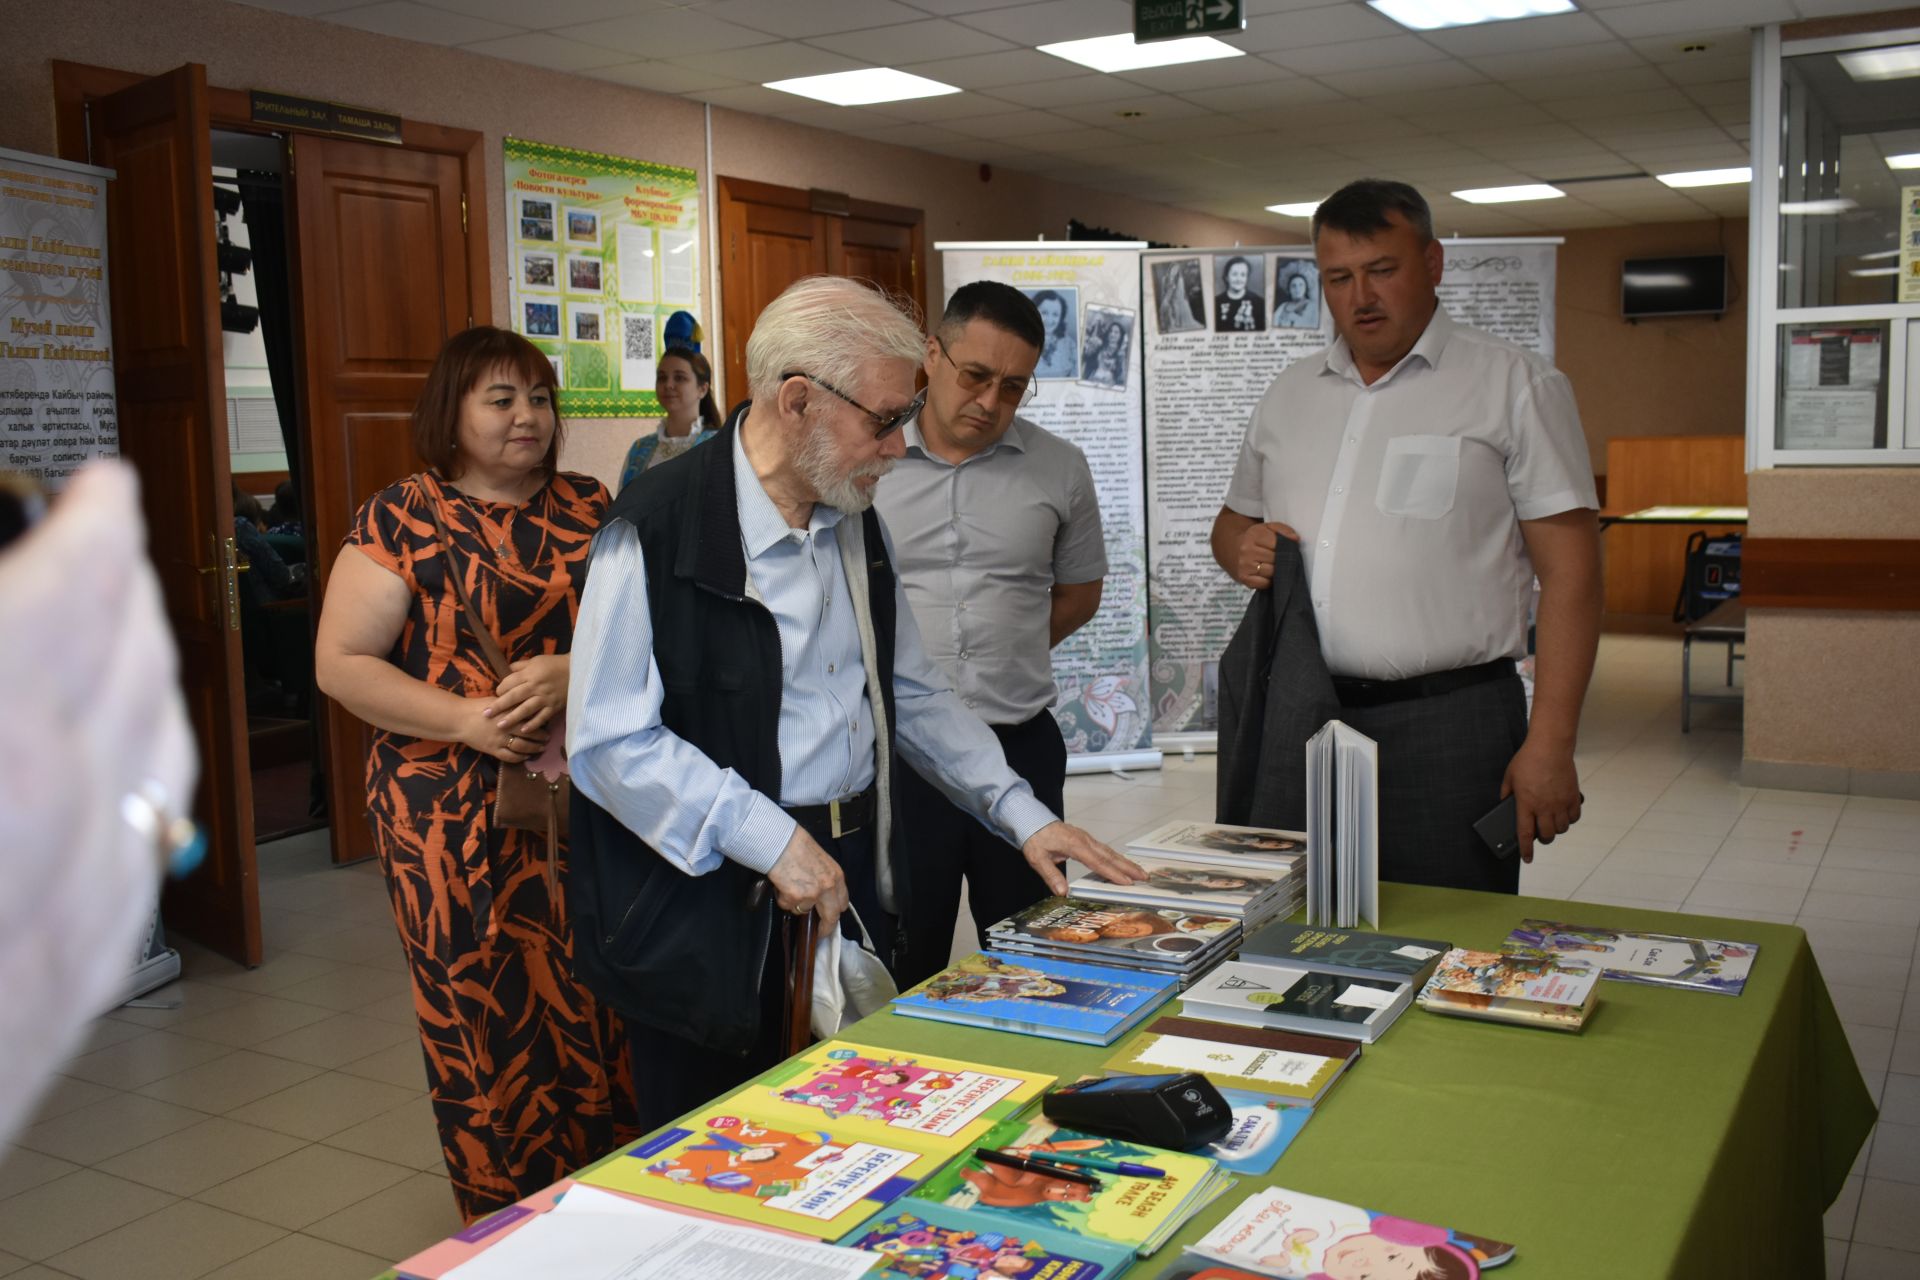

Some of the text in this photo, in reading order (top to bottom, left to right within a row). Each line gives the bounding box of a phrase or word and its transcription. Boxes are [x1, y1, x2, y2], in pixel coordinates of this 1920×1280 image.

[0, 389, 114, 402] ктяберендә Кайбыч районы
[0, 407, 33, 416] ылында
[46, 407, 80, 415] ачылган
[8, 420, 117, 433] халык артисткасы, Муса
[0, 439, 19, 450] атар
[21, 439, 50, 449] дәүләт
[53, 437, 77, 448] опера
[80, 435, 95, 445] һәм
[9, 453, 41, 465] баручы
[53, 453, 88, 462] солисты
[919, 1078, 1000, 1131] БЕРЕНЧЕ АДЫМ
[799, 1151, 893, 1210] БЕРЕНЧЕ КӨН
[1114, 1181, 1151, 1206] ТӨЛКЕ
[1129, 1190, 1167, 1218] БЕЛӘН
[1052, 1260, 1084, 1280] НӘН
